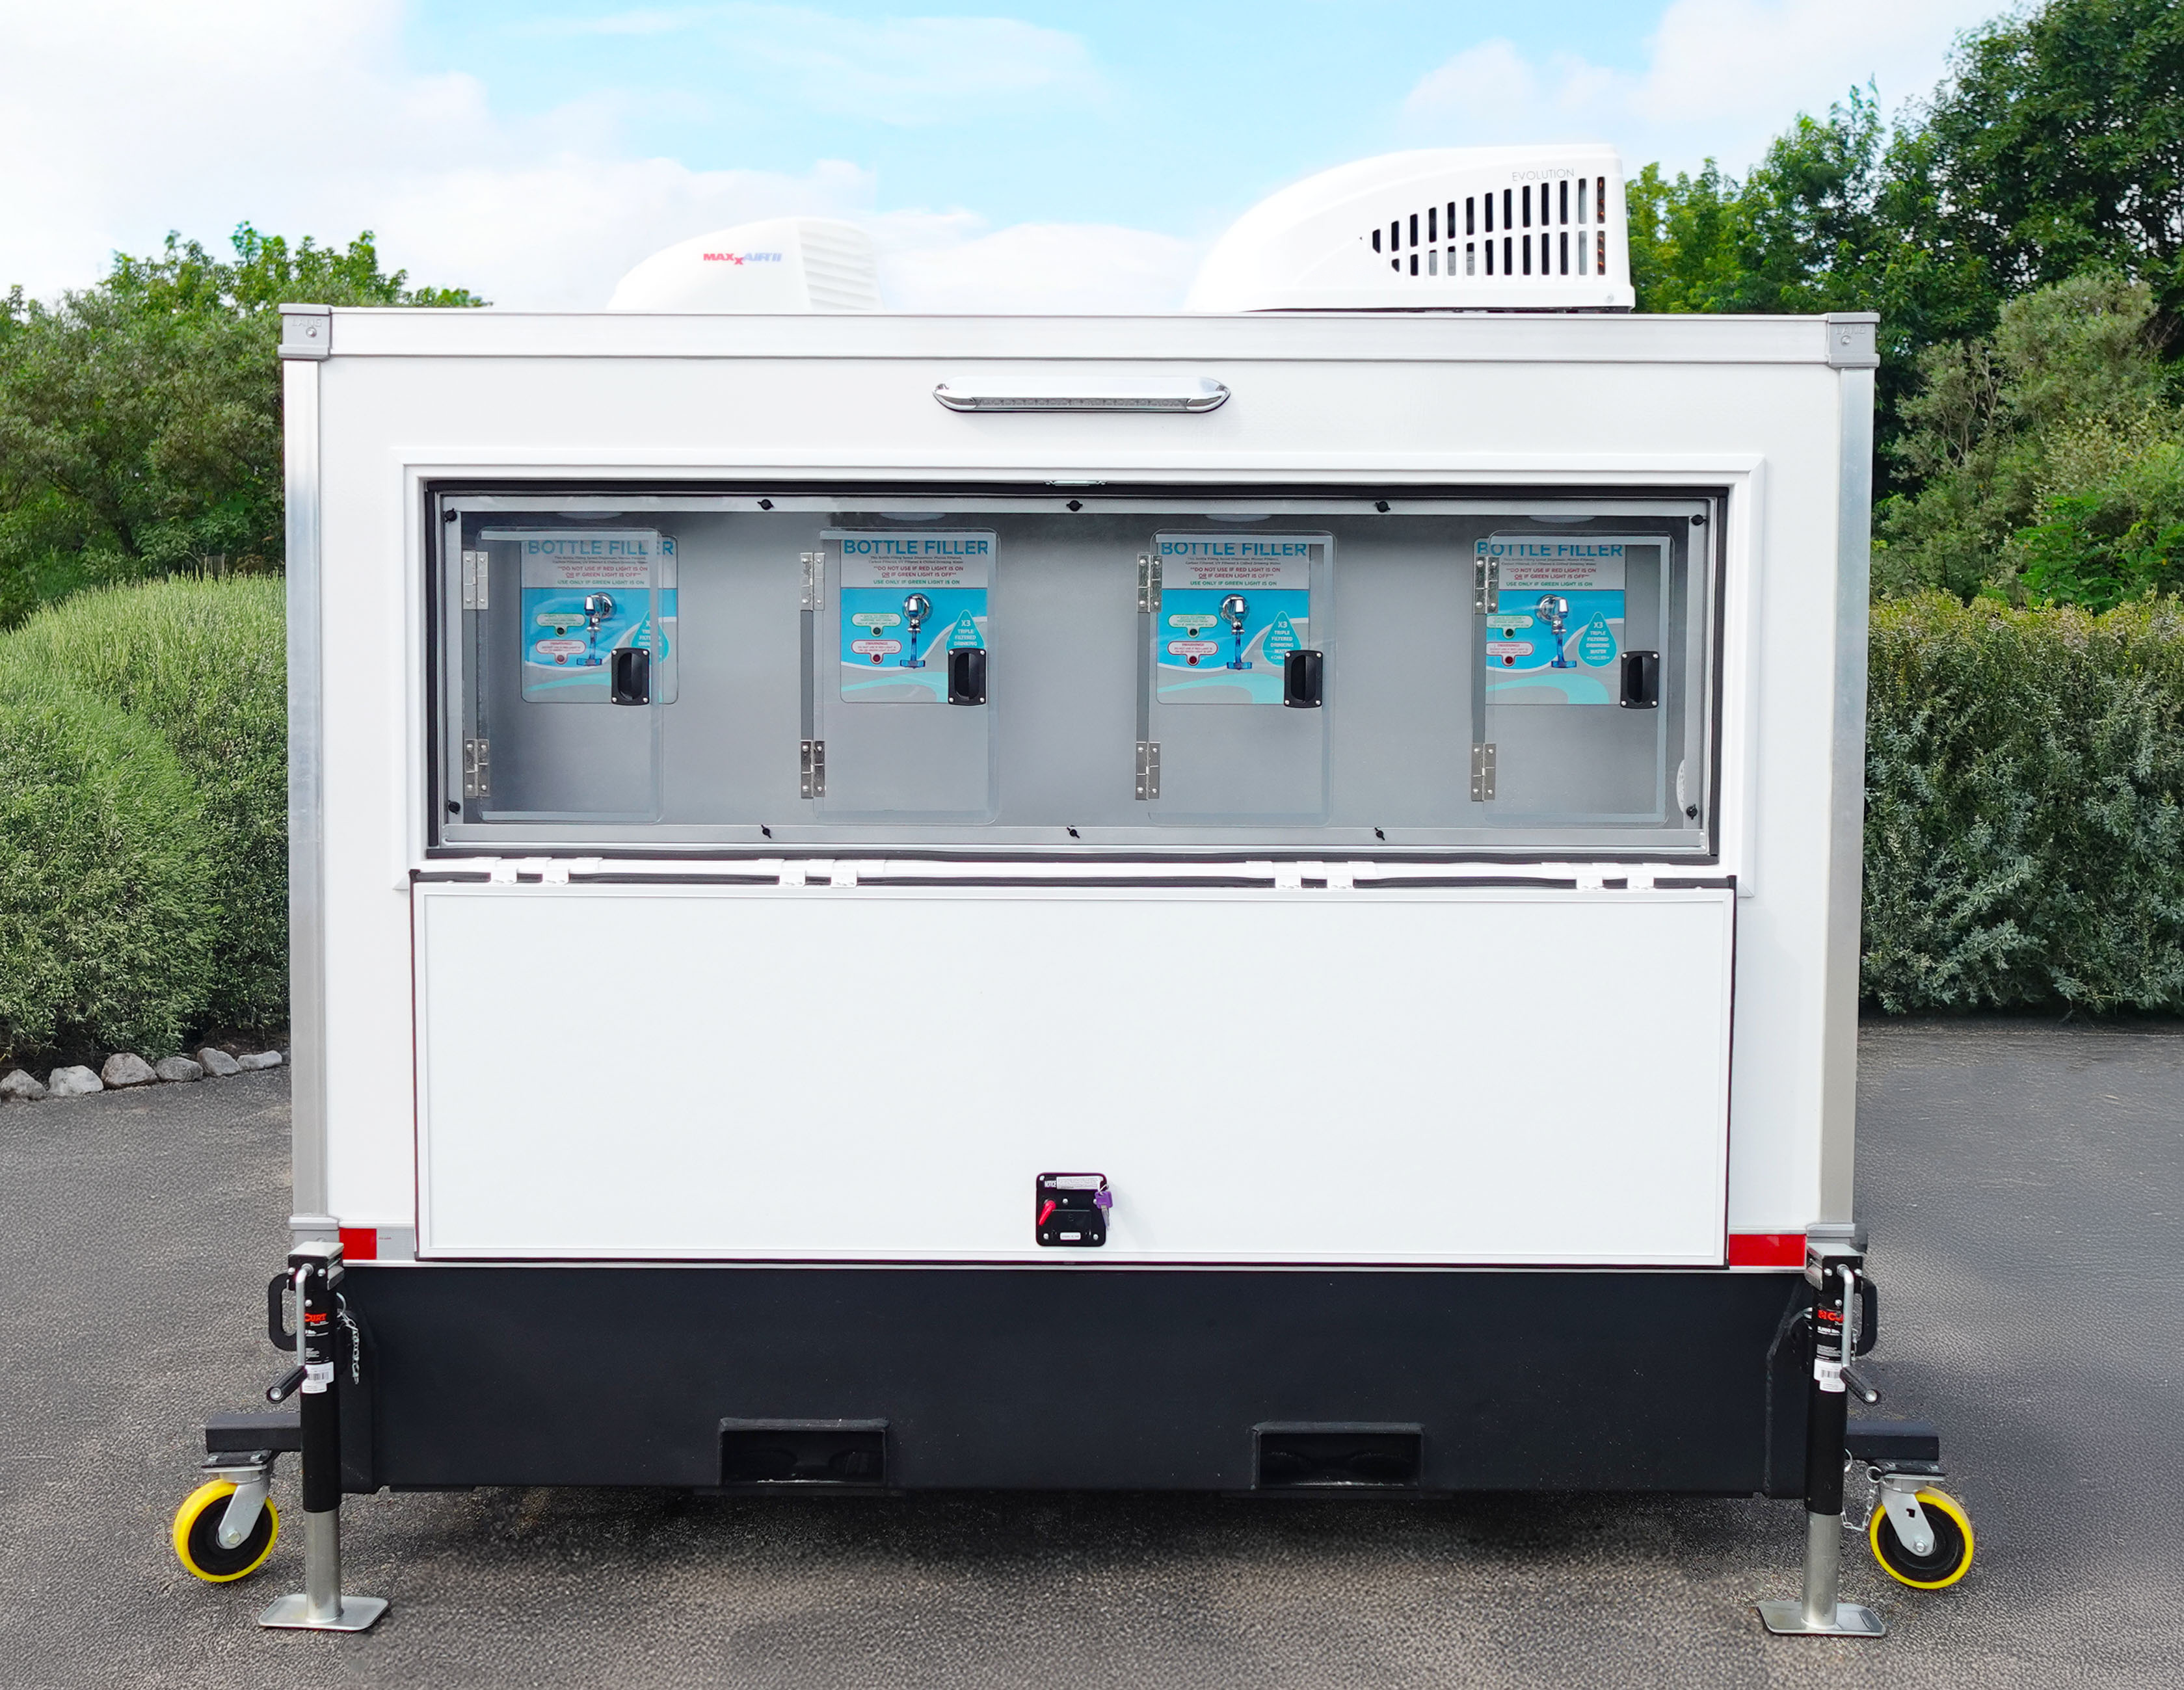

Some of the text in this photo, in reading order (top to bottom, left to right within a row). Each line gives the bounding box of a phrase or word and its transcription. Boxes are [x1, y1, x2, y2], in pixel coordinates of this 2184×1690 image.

[1511, 168, 1575, 181] EVOLUTION
[528, 540, 602, 554] BOTTLE
[844, 540, 988, 555] BOTTLE FILLER
[1161, 542, 1307, 556] BOTTLE FILLER
[1477, 542, 1623, 557] BOTTLE FILLER
